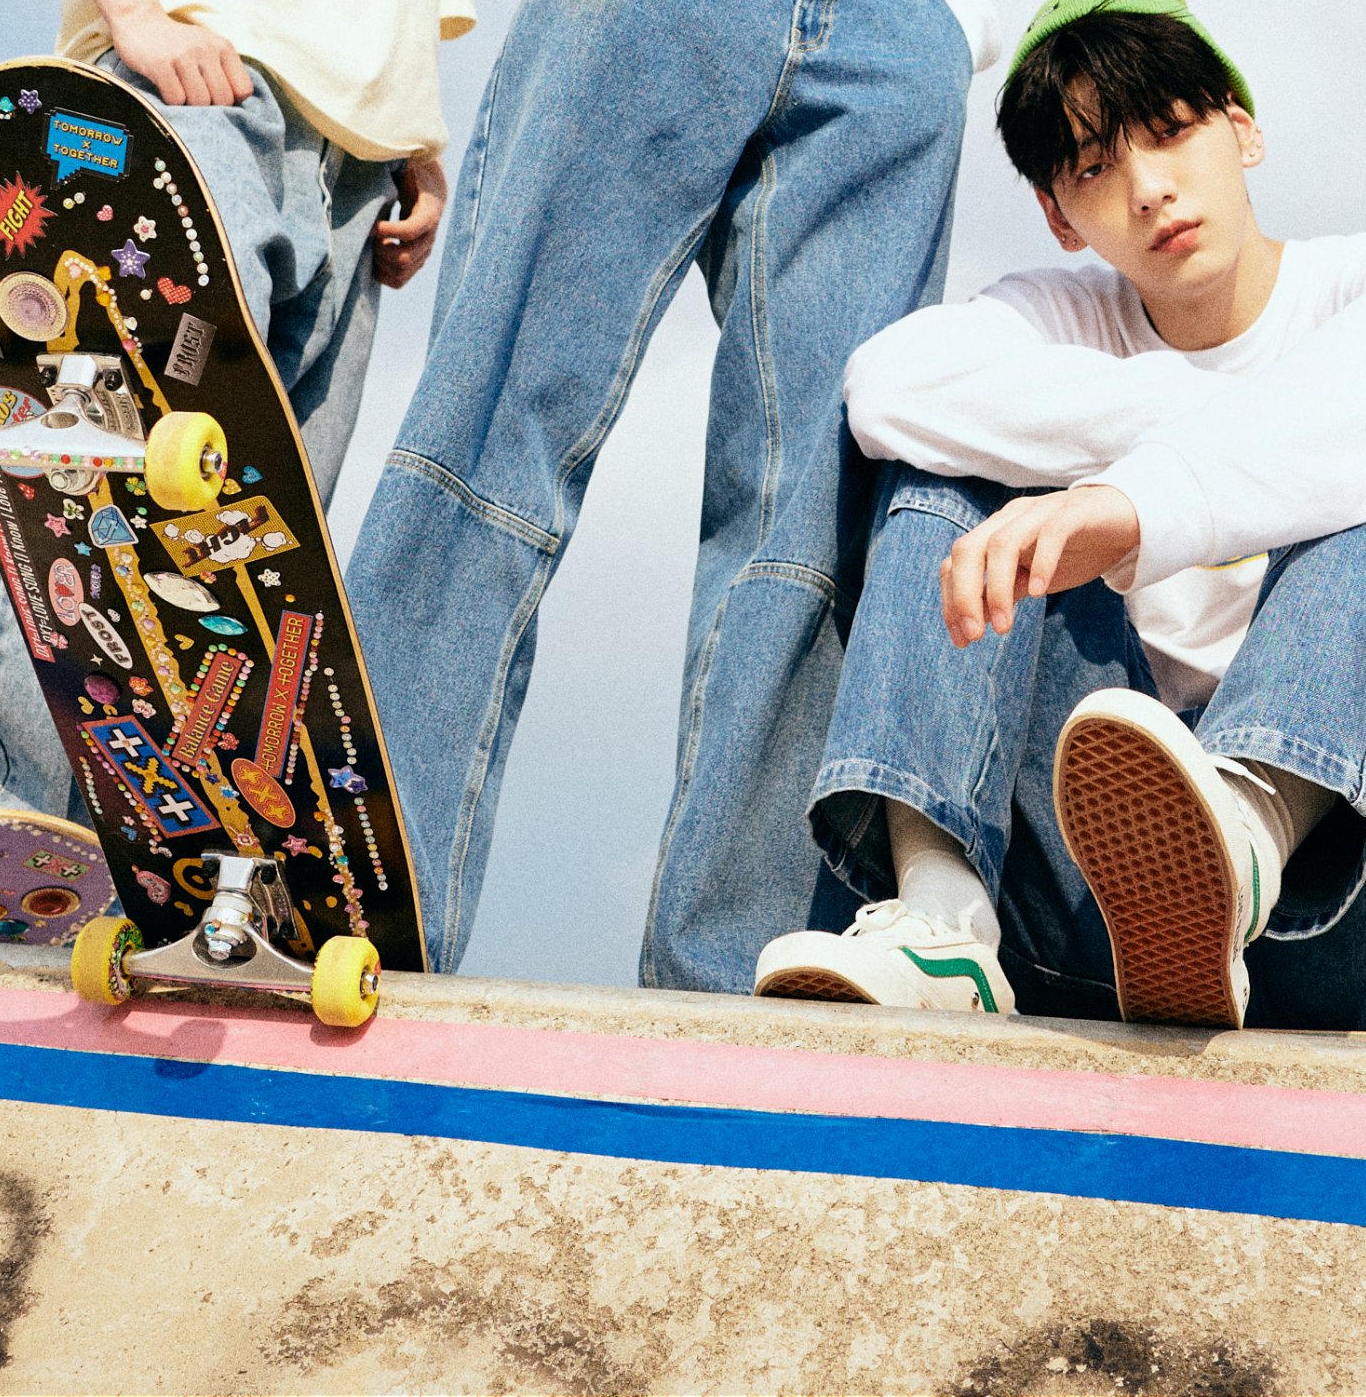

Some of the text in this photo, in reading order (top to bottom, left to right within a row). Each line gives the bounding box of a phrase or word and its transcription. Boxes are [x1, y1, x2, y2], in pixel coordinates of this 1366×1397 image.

[53, 120, 123, 146] TOMORROW
[82, 139, 91, 149] X
[53, 143, 118, 169] TOGETHER
[0, 190, 33, 241] FIGHT
[6, 520, 26, 552] Know
[183, 504, 270, 569] FIGHT
[18, 563, 40, 593] SONG
[81, 609, 130, 664] FROST
[179, 660, 235, 760] Balance Game
